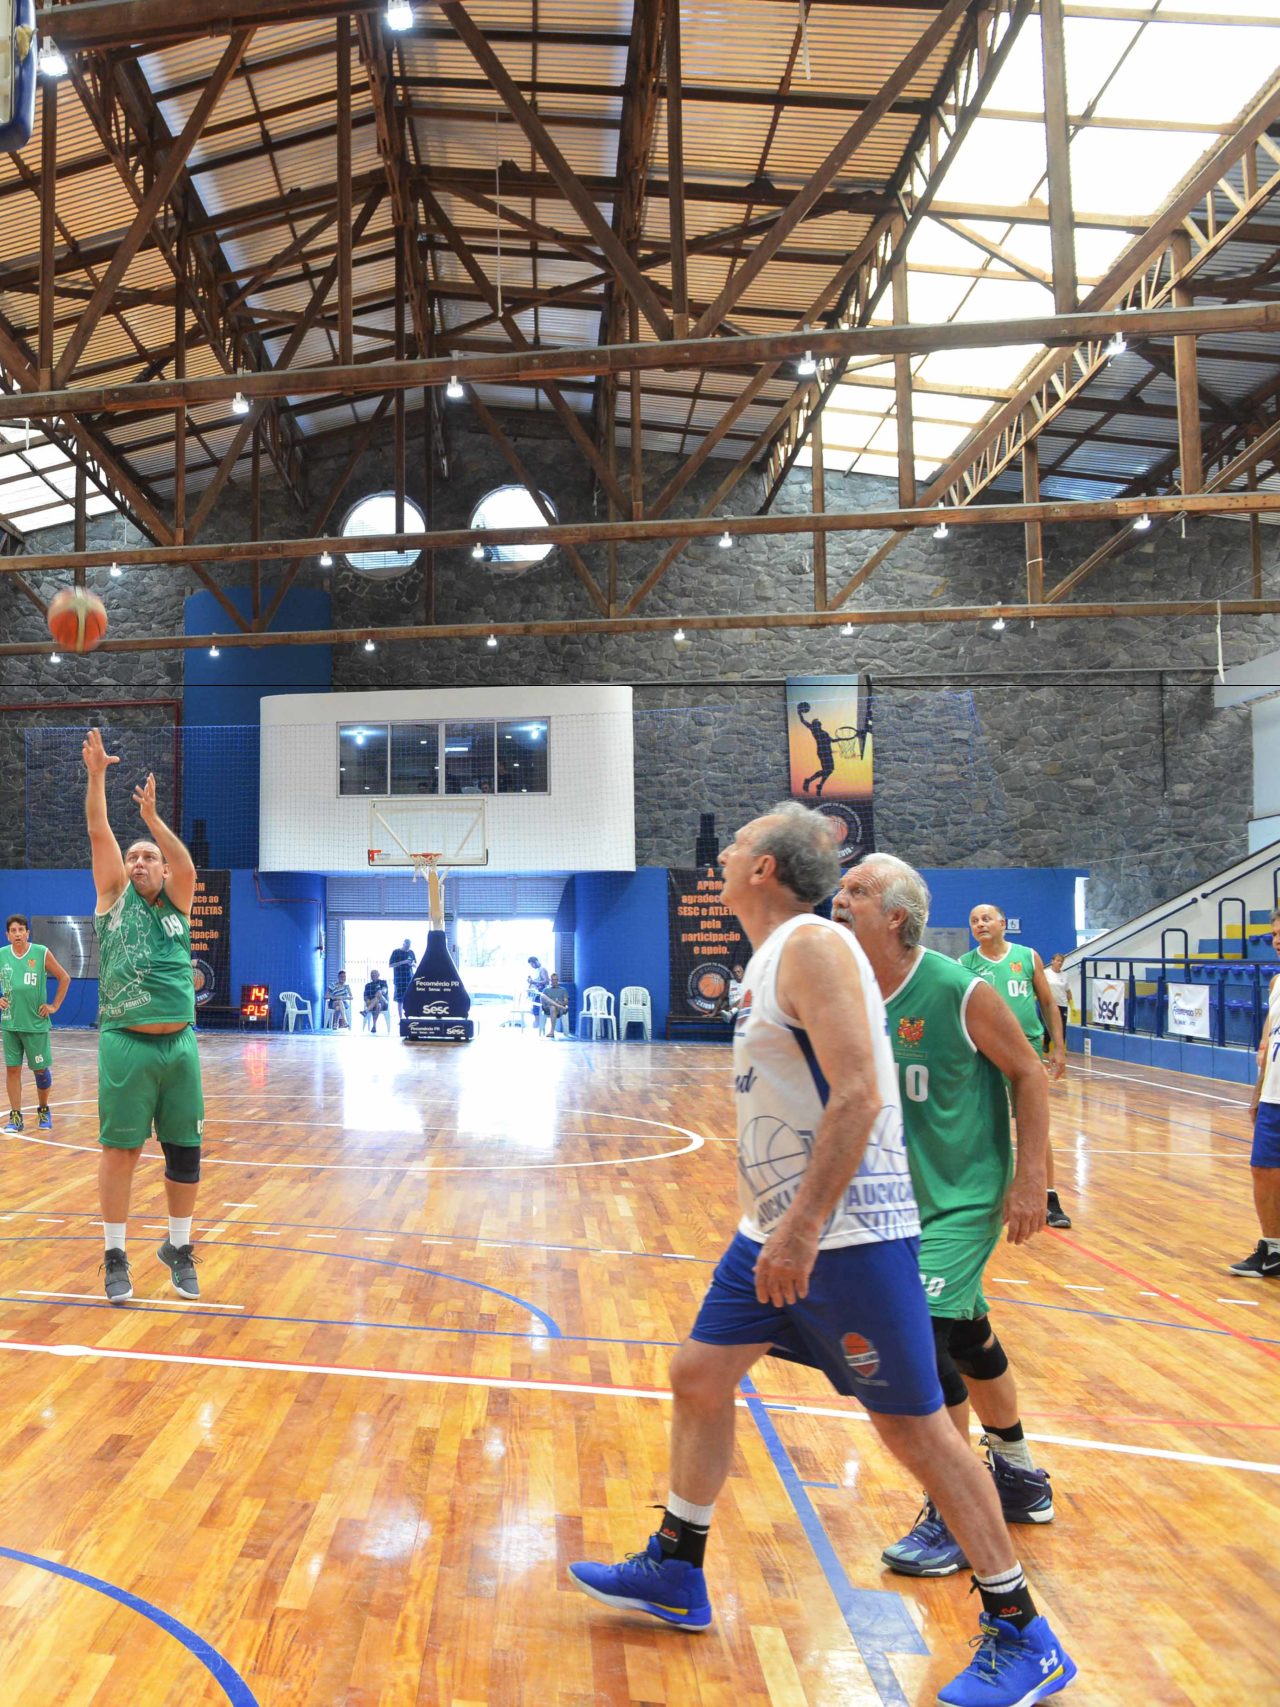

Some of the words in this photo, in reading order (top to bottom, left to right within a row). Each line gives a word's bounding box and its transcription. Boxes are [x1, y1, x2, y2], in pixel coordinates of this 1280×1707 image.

[707, 867, 715, 878] A
[194, 881, 205, 892] BM
[208, 895, 219, 904] ao
[682, 893, 721, 905] agradec
[192, 905, 223, 916] ATLETAS
[678, 905, 700, 916] SESC
[701, 907, 708, 916] e
[709, 905, 735, 916] ATLET
[160, 913, 185, 938] 09
[191, 918, 203, 928] ela
[700, 919, 722, 930] pela
[190, 930, 219, 941] cipação
[681, 931, 741, 943] participação
[191, 942, 210, 952] poio.
[693, 946, 700, 955] e
[701, 944, 730, 956] apoio.
[23, 972, 38, 986] 05
[1006, 978, 1029, 998] 04
[251, 987, 265, 1001] 14
[422, 1004, 450, 1015] Sesc
[34, 1054, 44, 1064] 05
[757, 1184, 802, 1226] AUCKL
